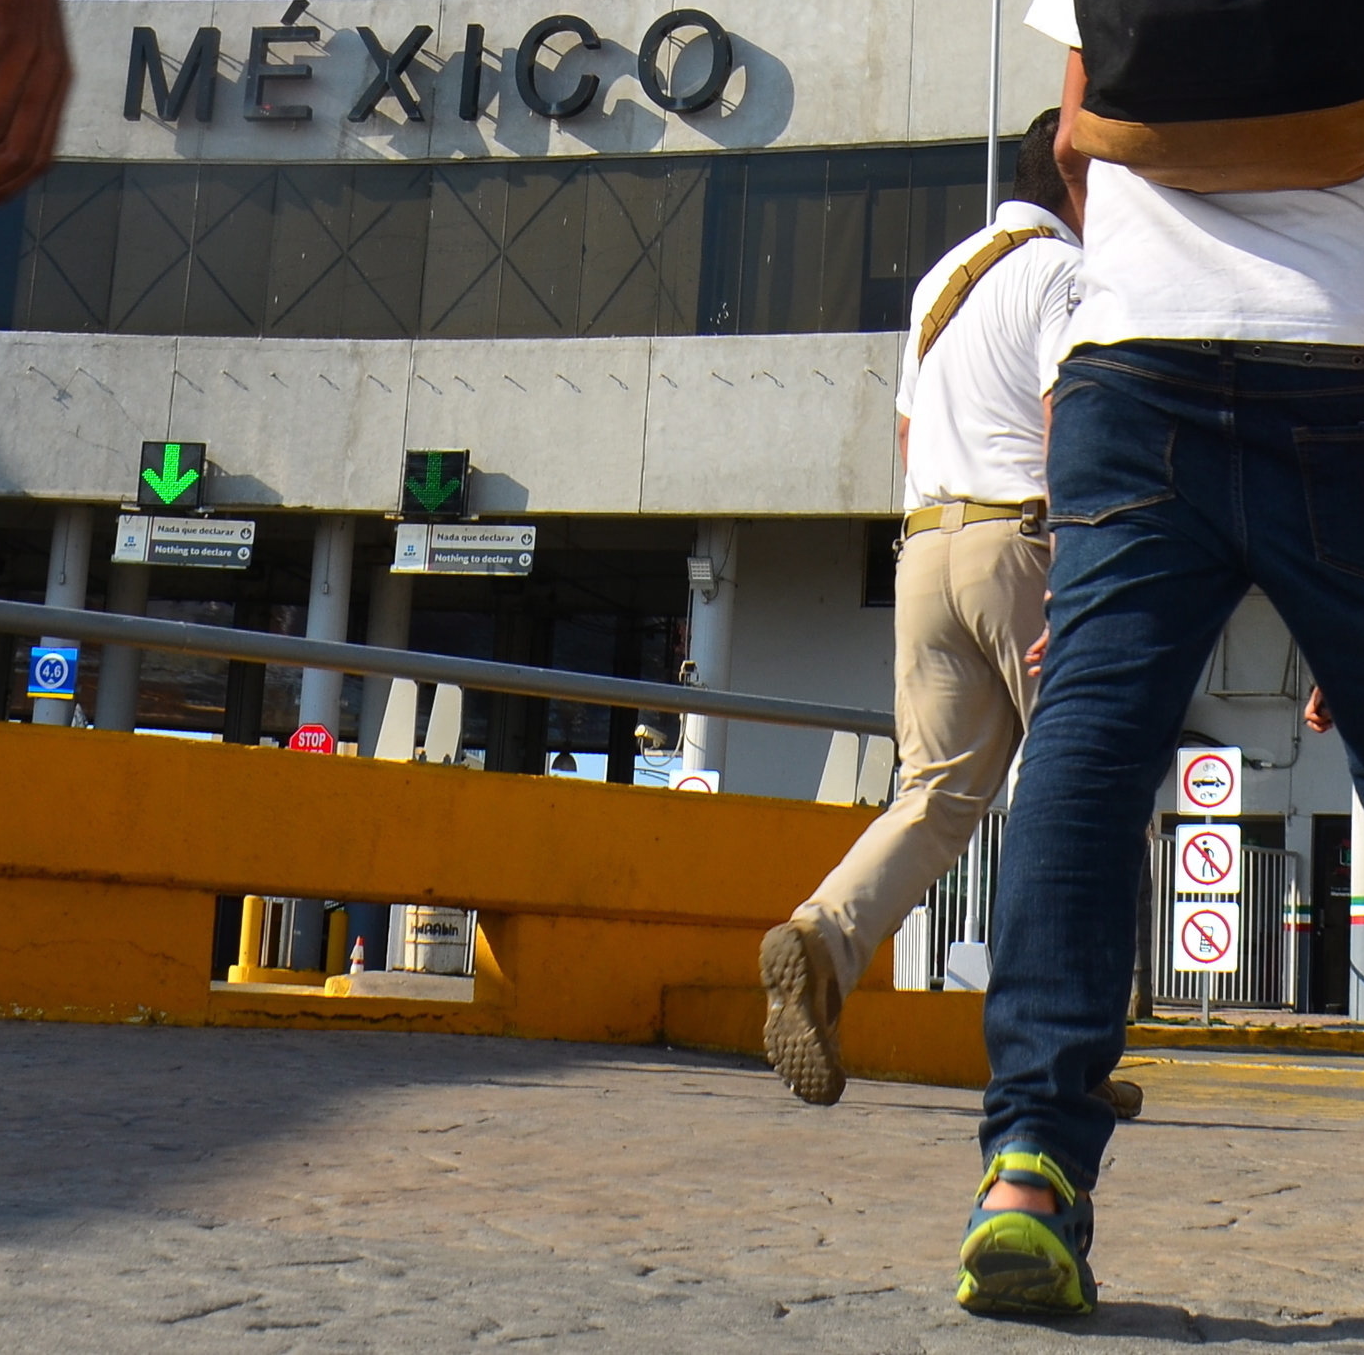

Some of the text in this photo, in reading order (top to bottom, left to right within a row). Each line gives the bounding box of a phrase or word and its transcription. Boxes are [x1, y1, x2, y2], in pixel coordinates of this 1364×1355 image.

[123, 0, 734, 123] MÉXICO
[157, 525, 234, 536] Nada que declarar
[437, 533, 514, 543] Nada que declarar
[154, 545, 232, 557] Nothing to declare
[434, 553, 513, 565] Nothing to declare
[298, 731, 327, 748] STOP
